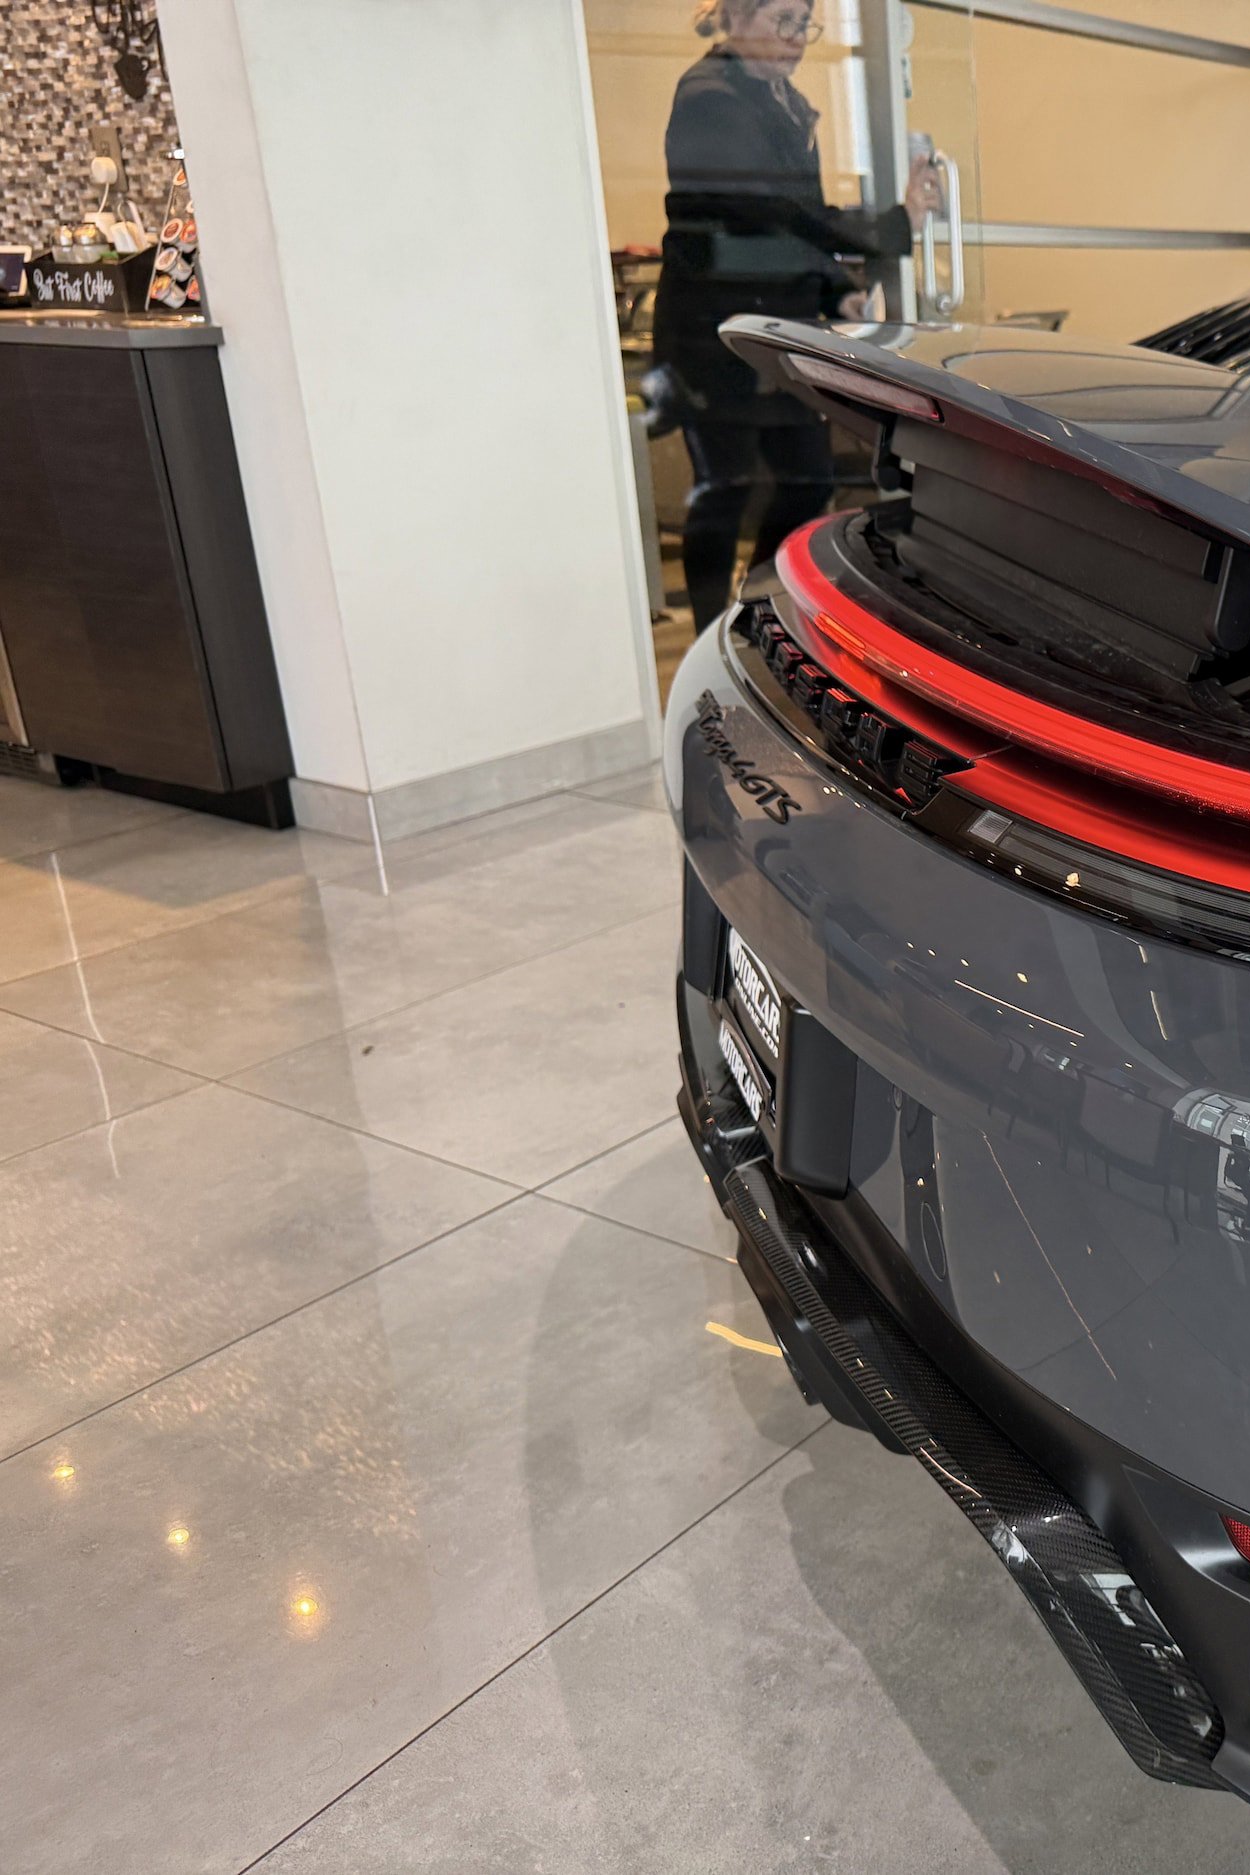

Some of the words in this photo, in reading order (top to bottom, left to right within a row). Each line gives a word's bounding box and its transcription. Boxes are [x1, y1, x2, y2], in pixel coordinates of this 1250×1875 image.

[33, 268, 54, 301] But
[55, 271, 82, 302] First
[84, 270, 114, 304] Coffee
[739, 775, 802, 825] GTS
[729, 930, 780, 1044] OTORCAR
[719, 1021, 762, 1122] MOTORCARS
